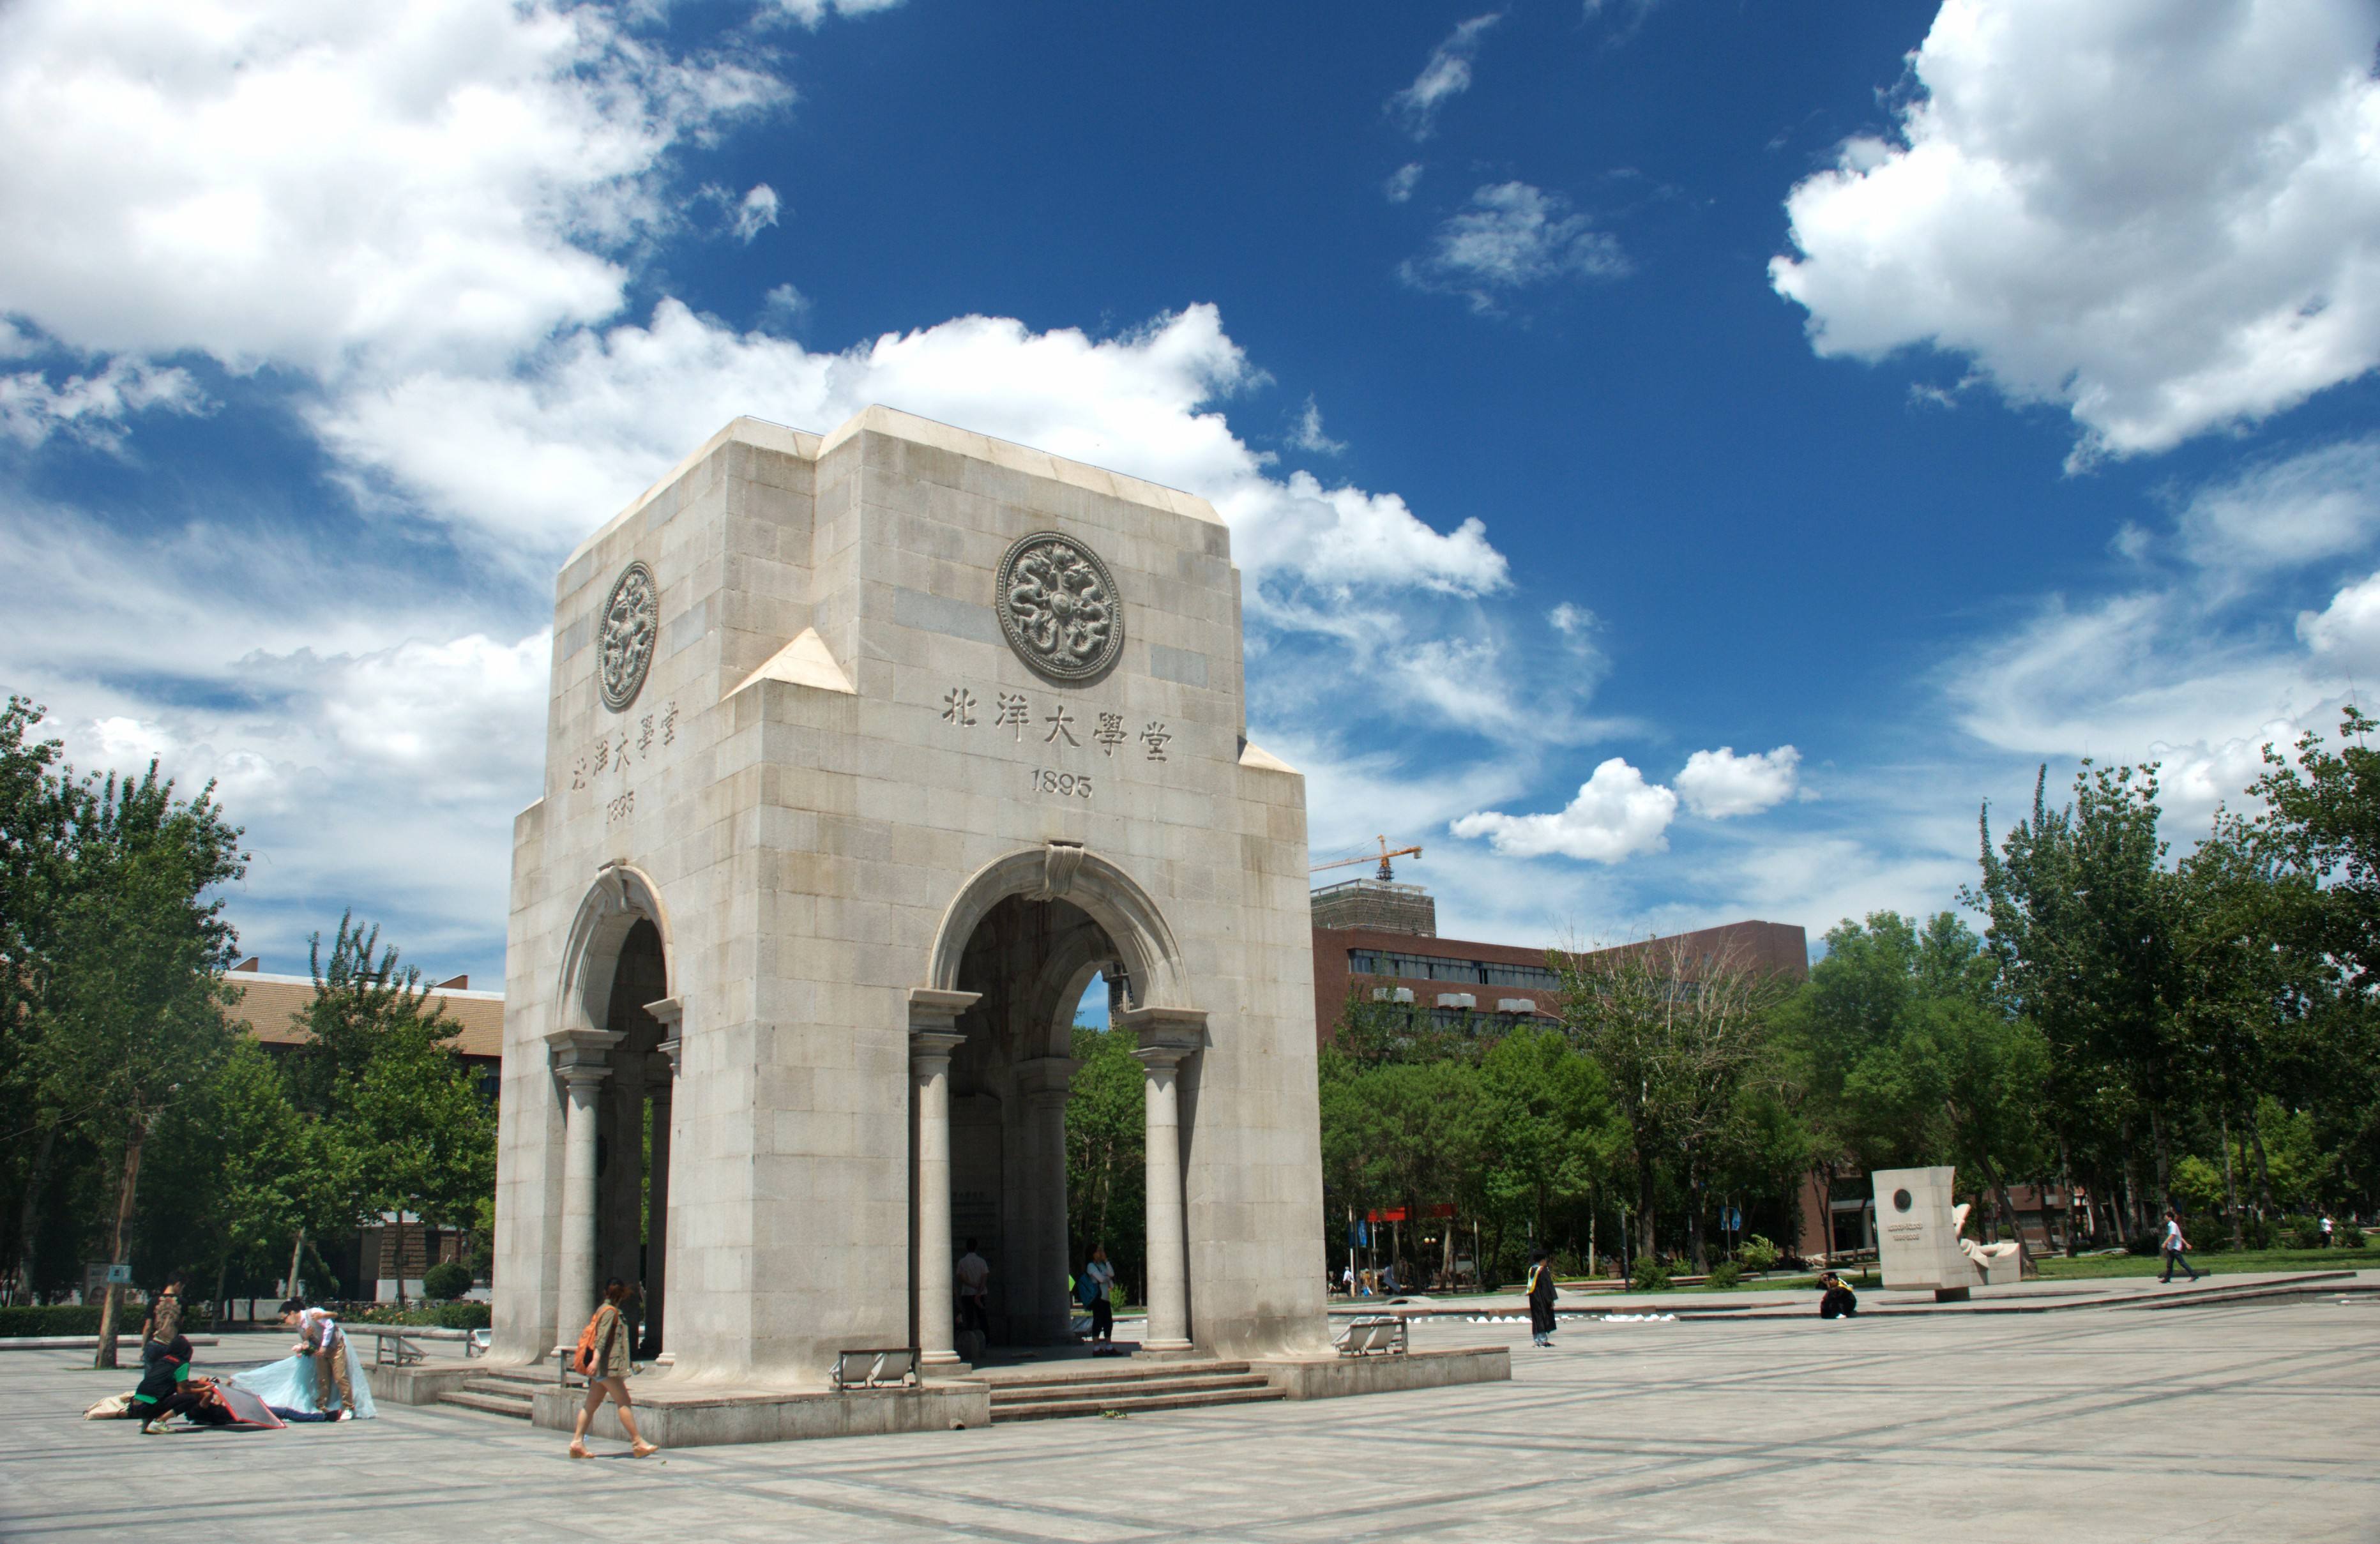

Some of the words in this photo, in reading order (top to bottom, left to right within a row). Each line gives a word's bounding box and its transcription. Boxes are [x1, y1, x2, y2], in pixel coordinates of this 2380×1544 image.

[573, 701, 679, 792] 北洋大學堂
[942, 688, 1172, 762] 北洋大學堂
[606, 791, 634, 824] 1895
[1031, 769, 1093, 798] 1895
